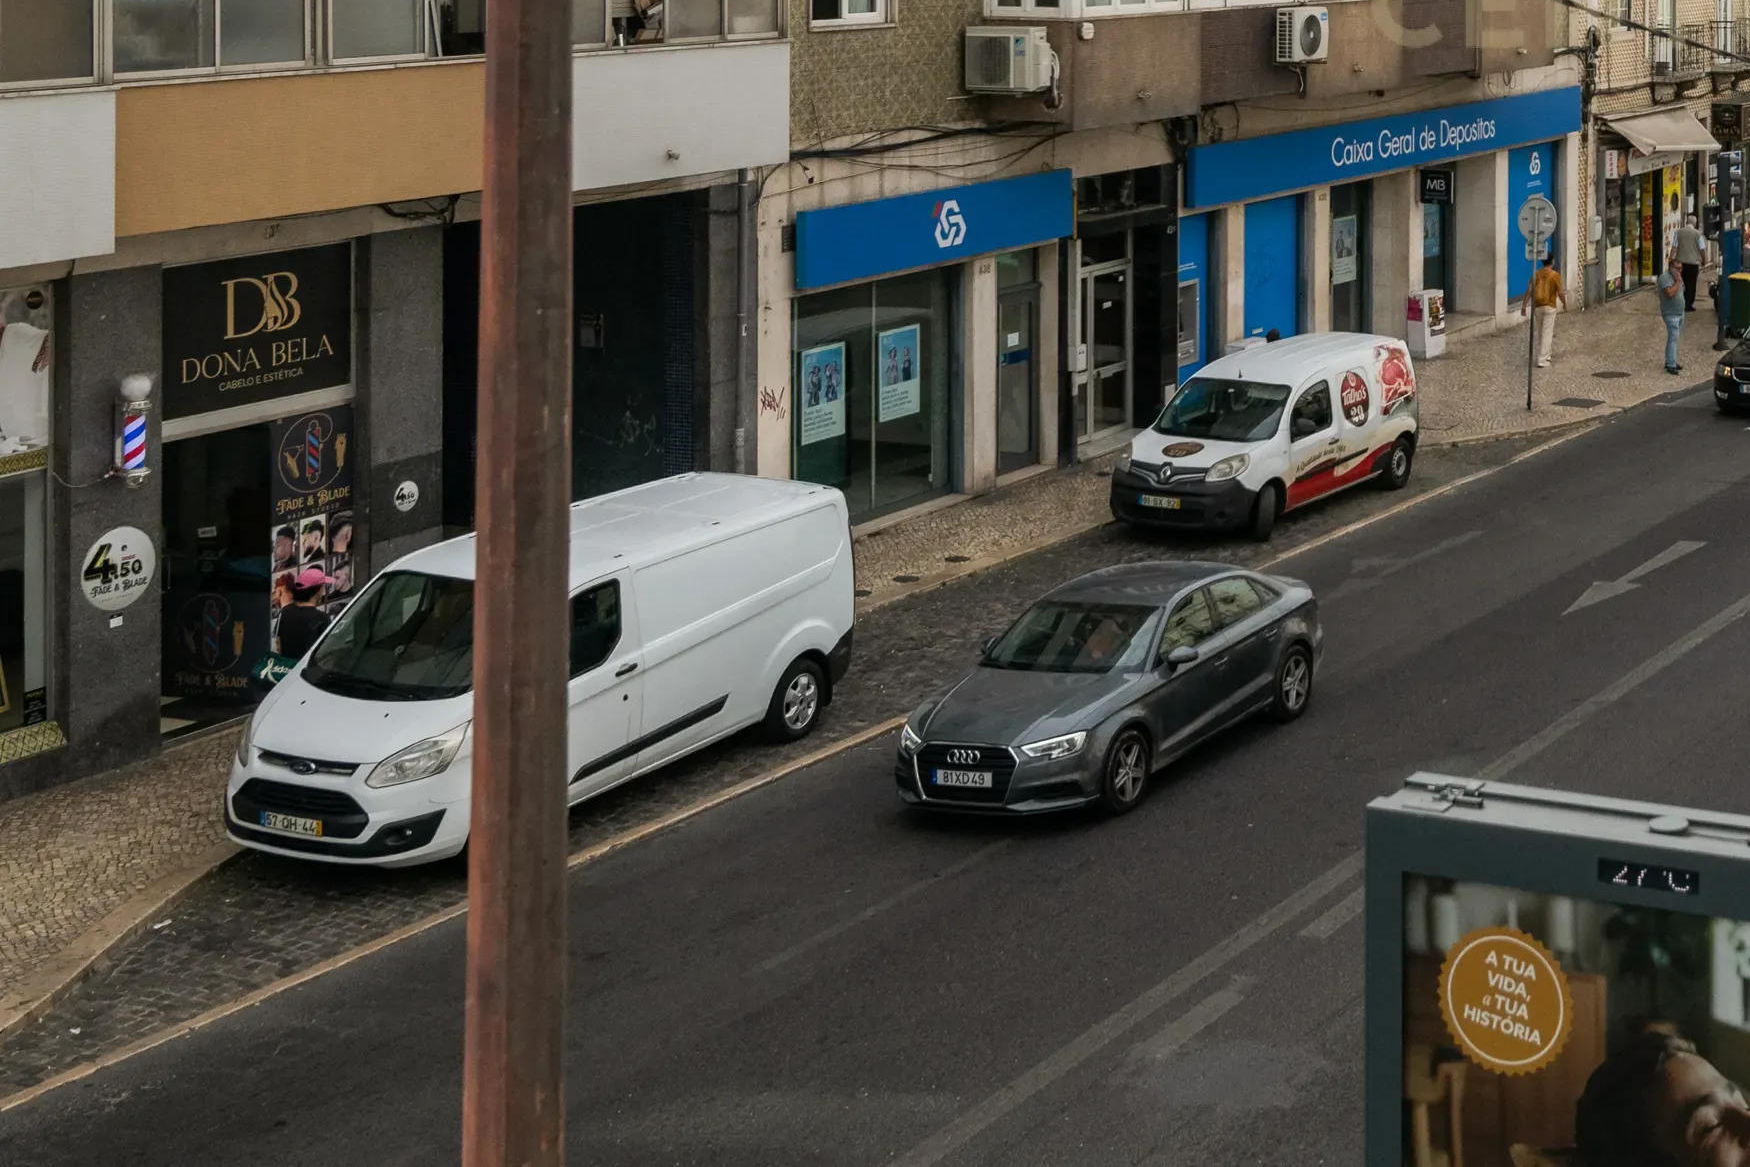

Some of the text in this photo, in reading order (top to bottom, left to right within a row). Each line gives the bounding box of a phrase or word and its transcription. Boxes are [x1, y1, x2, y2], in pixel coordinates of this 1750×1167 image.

[1331, 137, 1374, 167] Caixa
[1378, 129, 1415, 158] Geral
[1419, 125, 1436, 151] de
[1426, 179, 1446, 191] MB
[182, 334, 334, 383] DONA BELA
[218, 367, 304, 392] CABELO E ESTÉTICA
[1342, 386, 1367, 407] Talho's
[307, 495, 314, 506] &
[1485, 950, 1536, 981] A TUA
[1488, 970, 1531, 1002] VIDA,
[1483, 994, 1528, 1020] a TUA
[1464, 1004, 1541, 1045] HISTÓRIA
